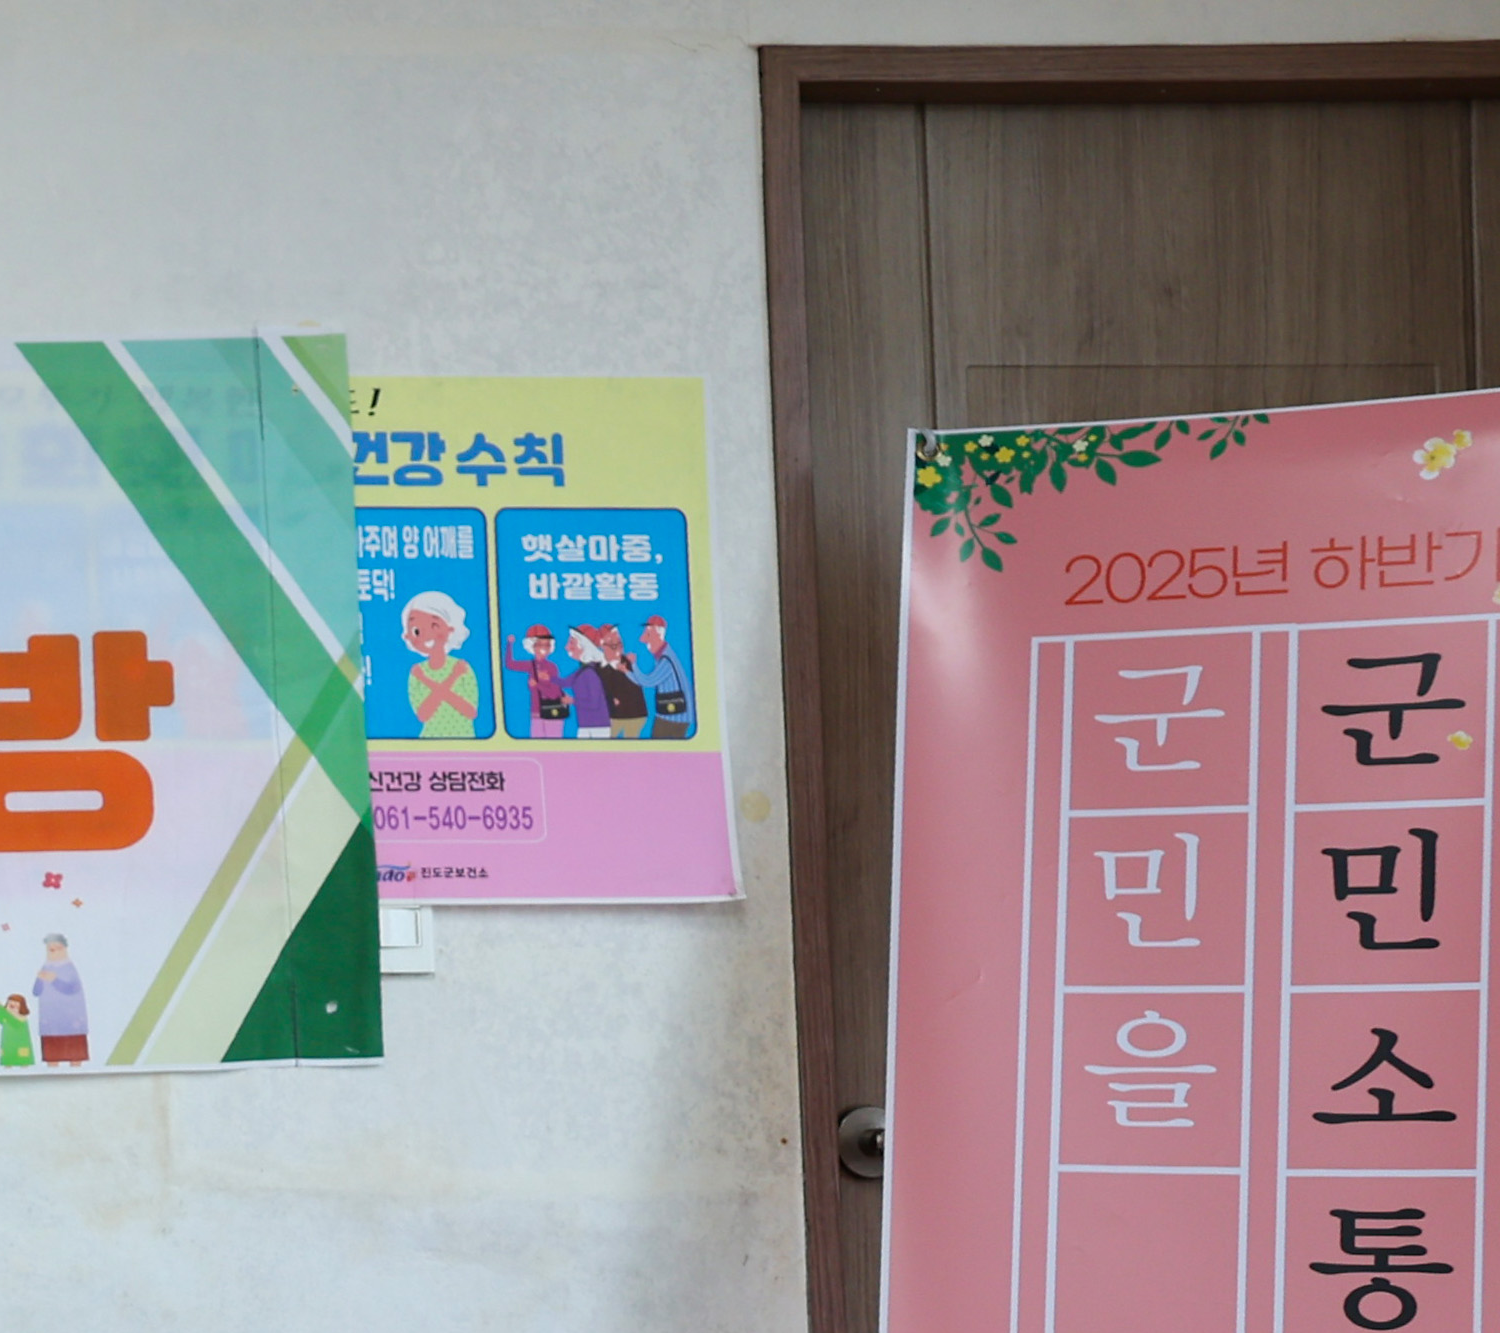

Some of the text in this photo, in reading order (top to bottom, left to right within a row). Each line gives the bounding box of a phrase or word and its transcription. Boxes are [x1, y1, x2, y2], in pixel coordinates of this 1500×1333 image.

[455, 432, 566, 487] 수칙
[402, 525, 420, 559] 양
[423, 525, 475, 559] 어깨를
[521, 533, 664, 565] 햇살마중,
[528, 572, 660, 601] 바깥활동
[1064, 538, 1290, 607] 2025년
[429, 770, 506, 792] 상담전화
[373, 804, 535, 831] 061-540-6935
[420, 866, 490, 880] 진도군보건소
